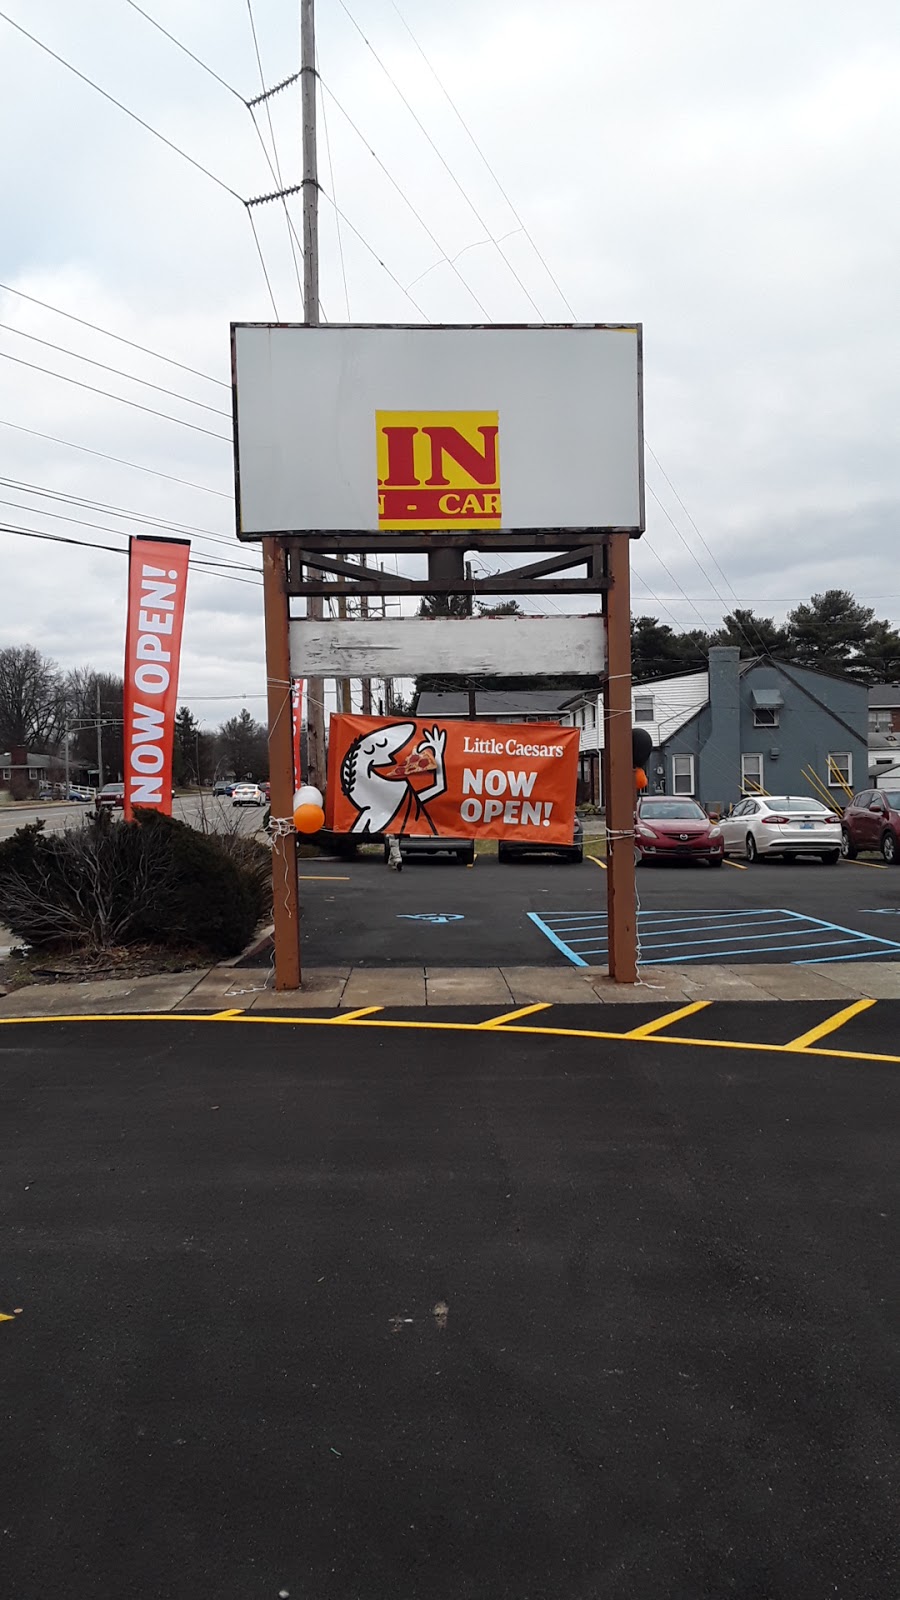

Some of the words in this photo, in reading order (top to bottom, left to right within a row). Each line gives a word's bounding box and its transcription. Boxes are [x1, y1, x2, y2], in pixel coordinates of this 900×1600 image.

[378, 426, 498, 486] IN
[438, 493, 501, 515] CAR
[134, 564, 178, 694] OPEN!
[130, 701, 165, 803] NOW
[463, 736, 503, 755] Little
[505, 739, 564, 758] Caesars
[462, 767, 538, 798] NOW
[460, 797, 554, 827] OPEN!
